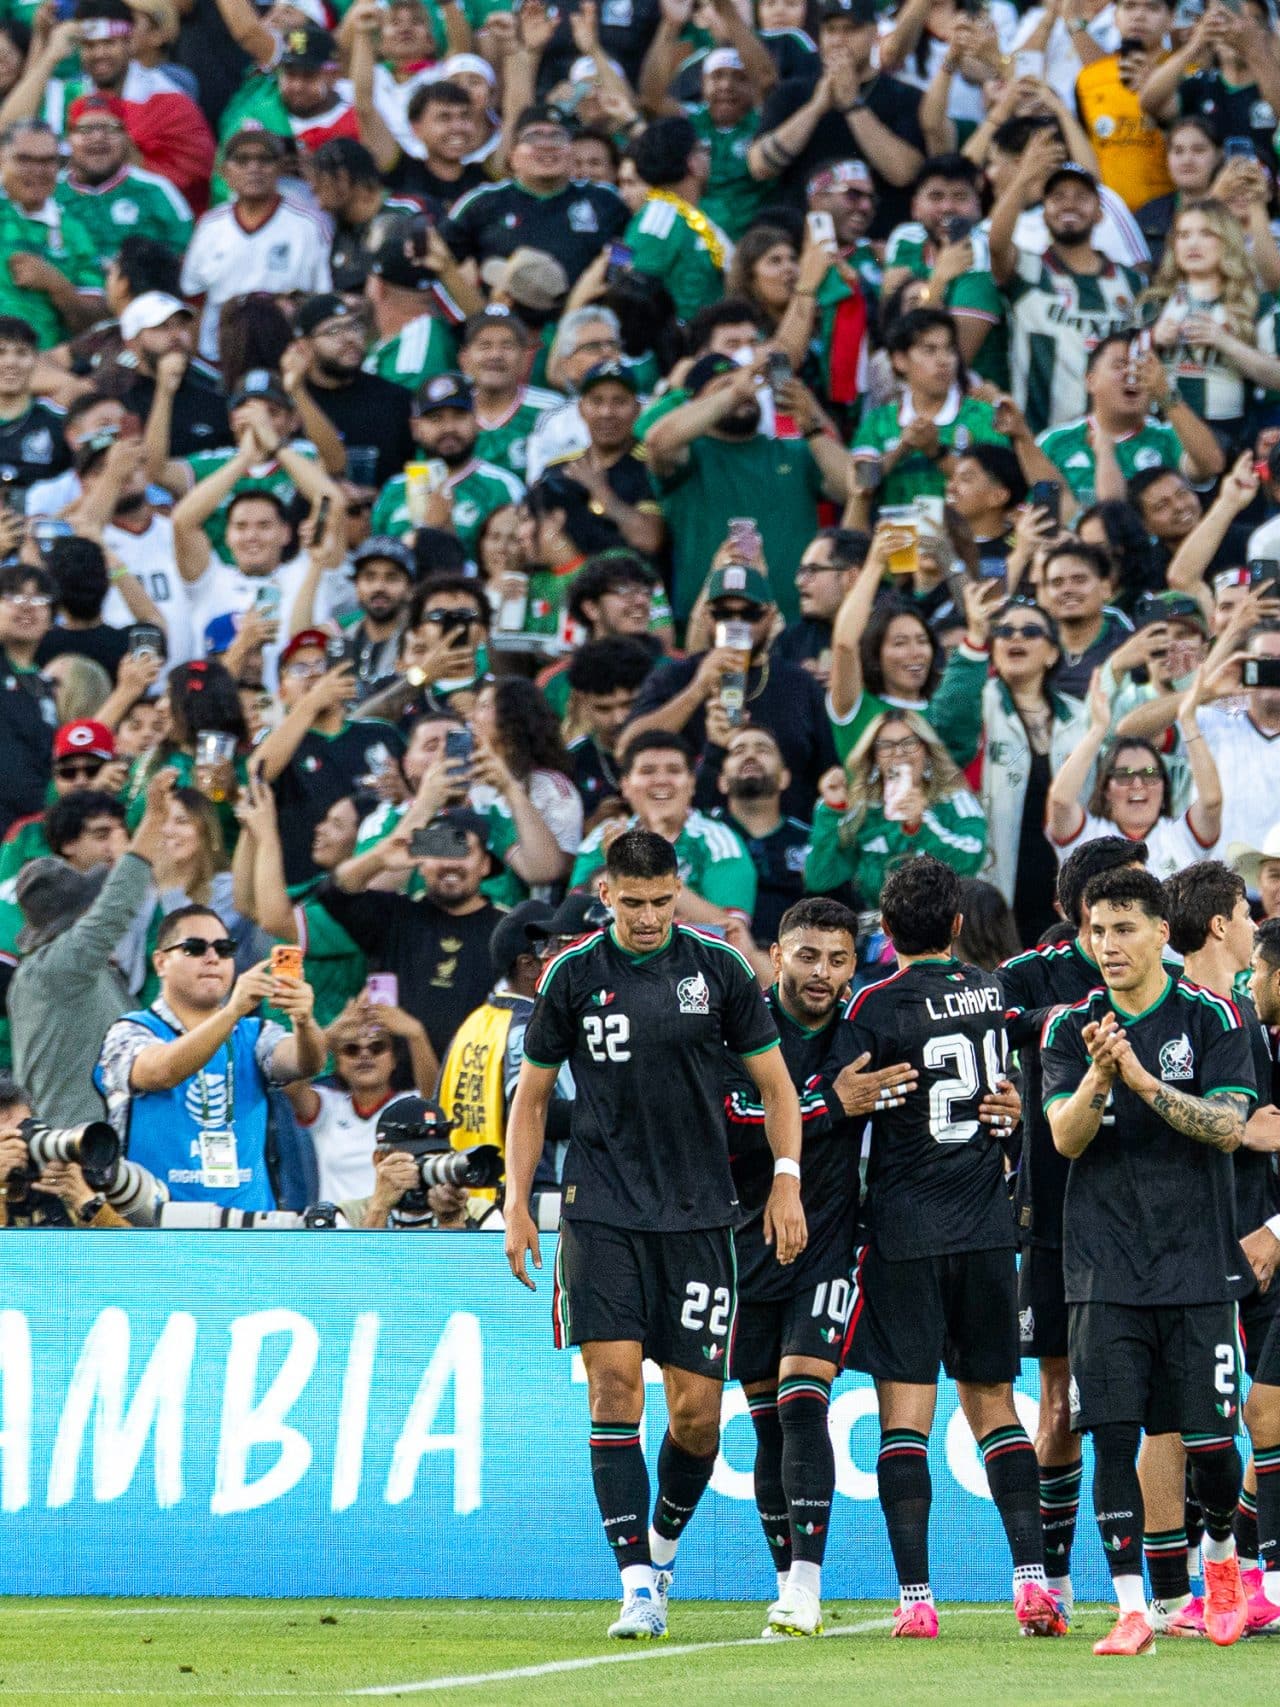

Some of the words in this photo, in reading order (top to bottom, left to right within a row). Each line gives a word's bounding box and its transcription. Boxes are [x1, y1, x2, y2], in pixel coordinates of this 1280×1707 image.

[926, 987, 1002, 1020] L.CHÁVEZ
[583, 1014, 632, 1062] 22
[681, 1281, 730, 1336] 22
[811, 1278, 849, 1323] 10
[1215, 1344, 1235, 1394] 2
[791, 1498, 832, 1508] MÉXICO
